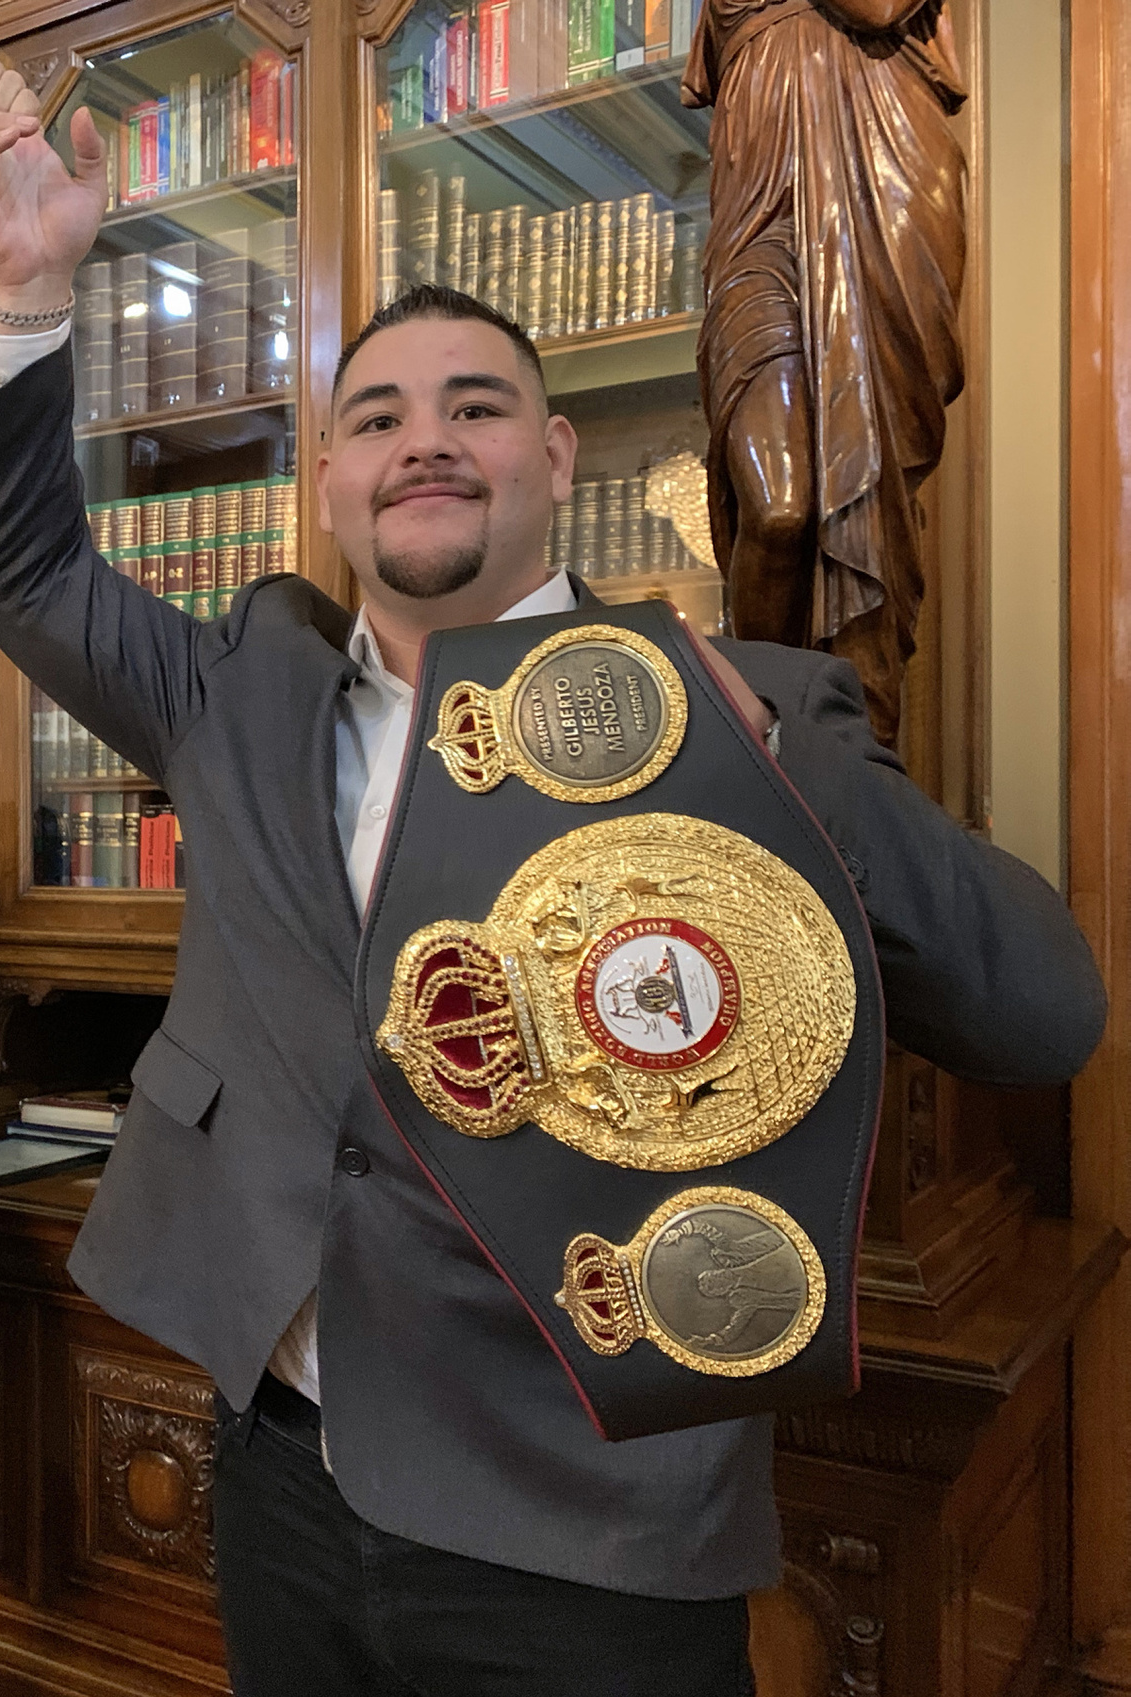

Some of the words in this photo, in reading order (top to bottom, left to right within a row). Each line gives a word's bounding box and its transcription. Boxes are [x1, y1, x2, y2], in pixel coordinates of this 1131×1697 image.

[530, 687, 541, 701] BY
[554, 677, 583, 757] GILBERTO
[576, 687, 600, 735] JESUS
[593, 662, 625, 752] MENDOZA
[627, 675, 648, 732] PRESIDENT
[532, 702, 553, 761] PRESENTED
[581, 921, 672, 994] ASSOCIATION
[698, 940, 738, 1028] CHAMPION
[581, 1000, 626, 1058] BOXING
[631, 1046, 701, 1068] WORLD
